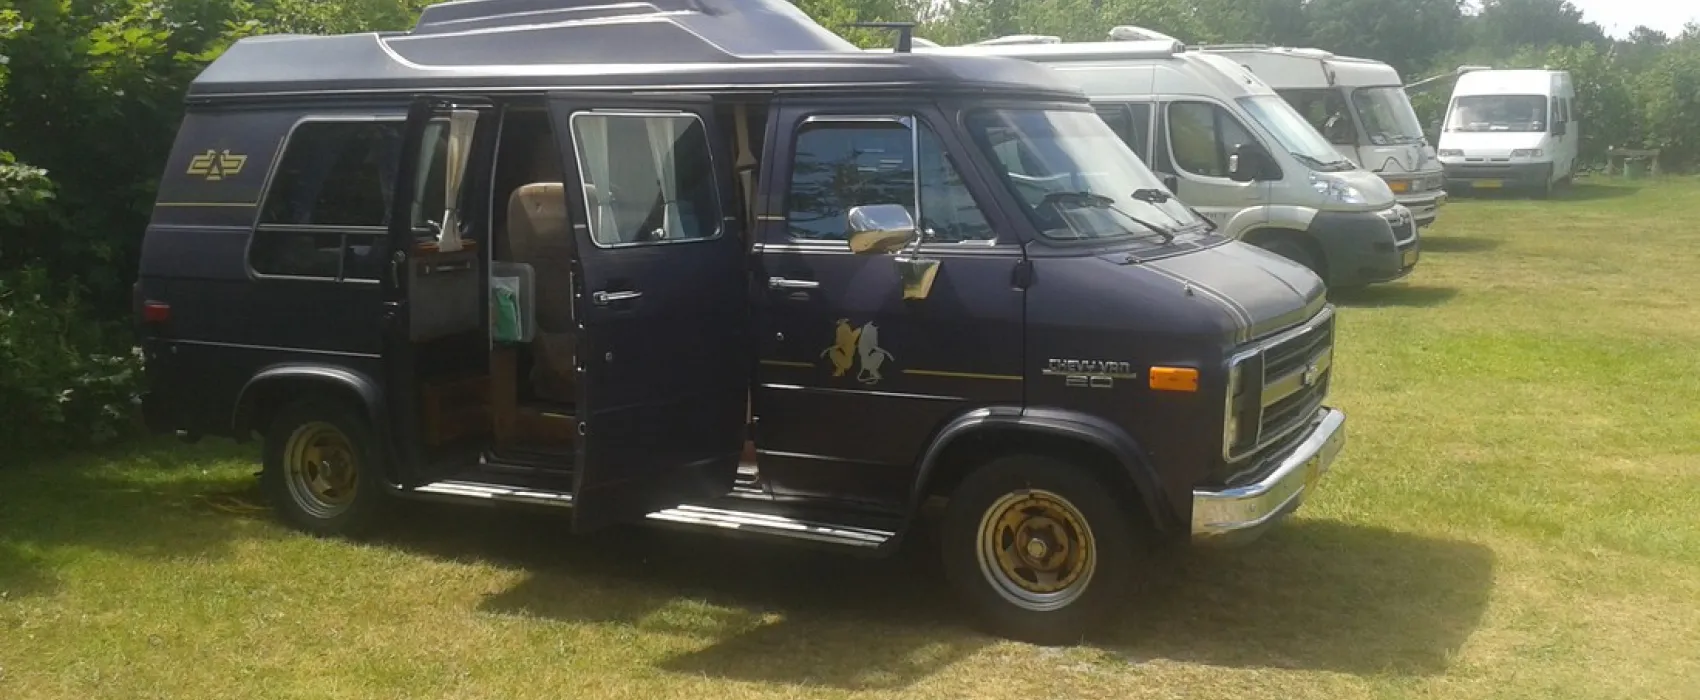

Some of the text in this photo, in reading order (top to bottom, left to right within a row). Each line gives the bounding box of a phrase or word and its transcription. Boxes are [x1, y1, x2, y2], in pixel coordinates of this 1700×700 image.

[1048, 358, 1131, 374] CHEVY VAN
[1065, 375, 1113, 388] 20
